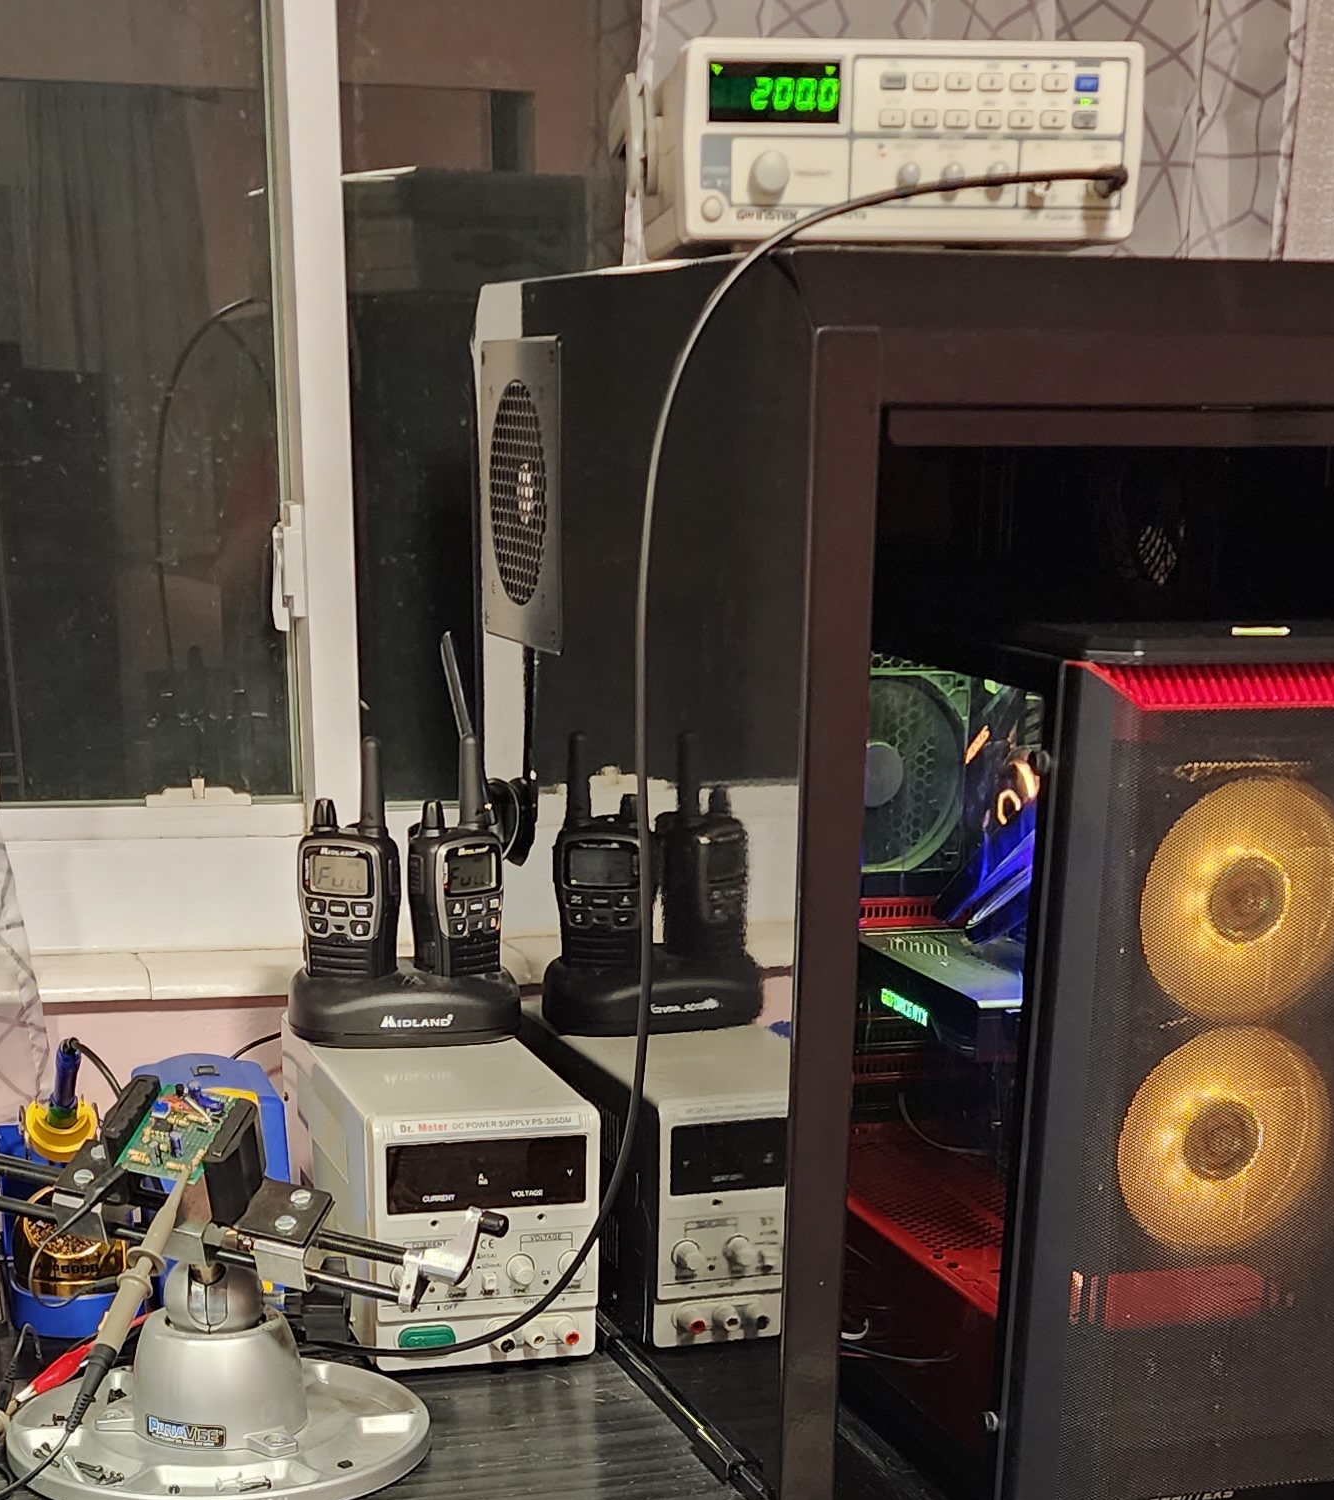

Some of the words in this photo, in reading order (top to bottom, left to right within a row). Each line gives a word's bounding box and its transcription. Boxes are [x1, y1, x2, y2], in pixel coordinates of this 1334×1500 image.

[380, 1014, 453, 1028] MIDLAND
[400, 1124, 414, 1133] Dr.
[418, 1122, 448, 1133] Meter
[452, 1122, 464, 1130] DC
[466, 1120, 497, 1129] POWER
[498, 1118, 530, 1128] SUPPLY
[511, 1188, 544, 1198] VOLTAGE
[422, 1193, 456, 1204] CURRENT
[529, 1233, 563, 1243] VOLTAGE
[444, 1303, 459, 1312] OFF
